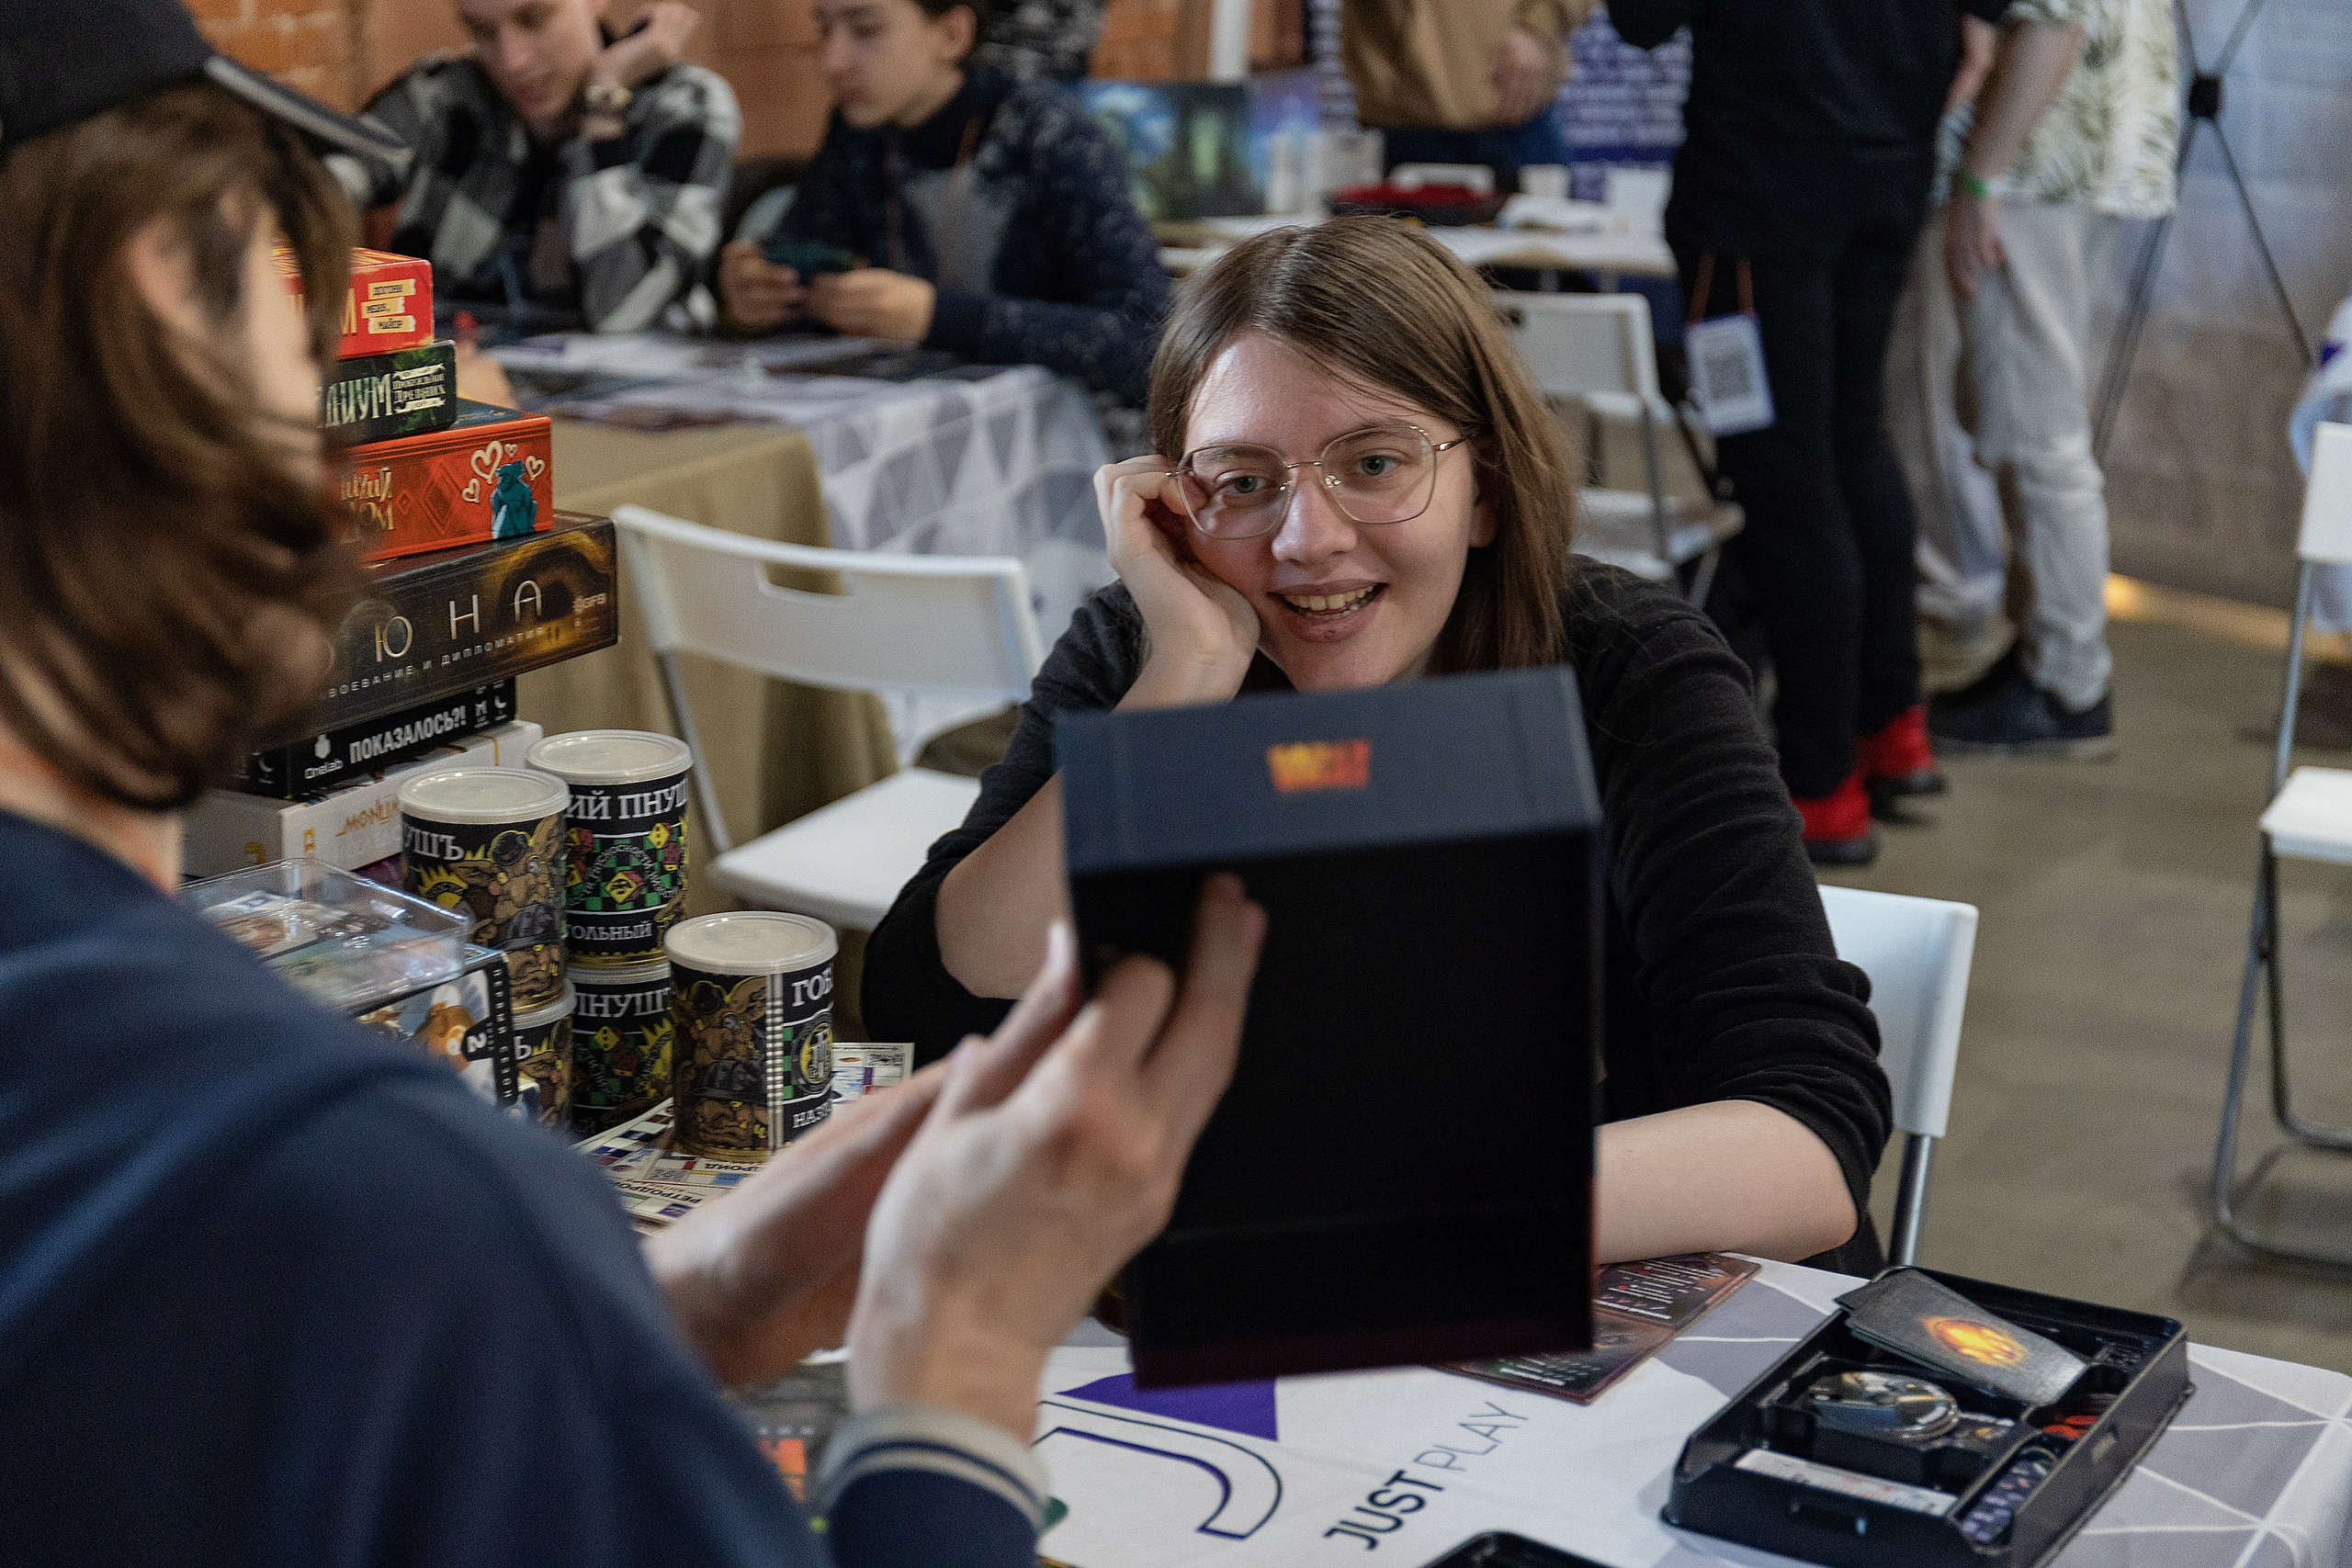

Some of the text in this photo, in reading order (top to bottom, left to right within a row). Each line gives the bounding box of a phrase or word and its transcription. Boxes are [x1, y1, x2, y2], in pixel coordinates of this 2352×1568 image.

[423, 660, 433, 671] И
[440, 626, 545, 667] ДИПЛОМАТИЯ
[349, 705, 467, 764] ПОКАЗАЛОСЬ?!
[566, 919, 652, 941] ОЛЬНЫЙ
[466, 1032, 488, 1054] 2
[1322, 1401, 1530, 1551] JUST PLAY
